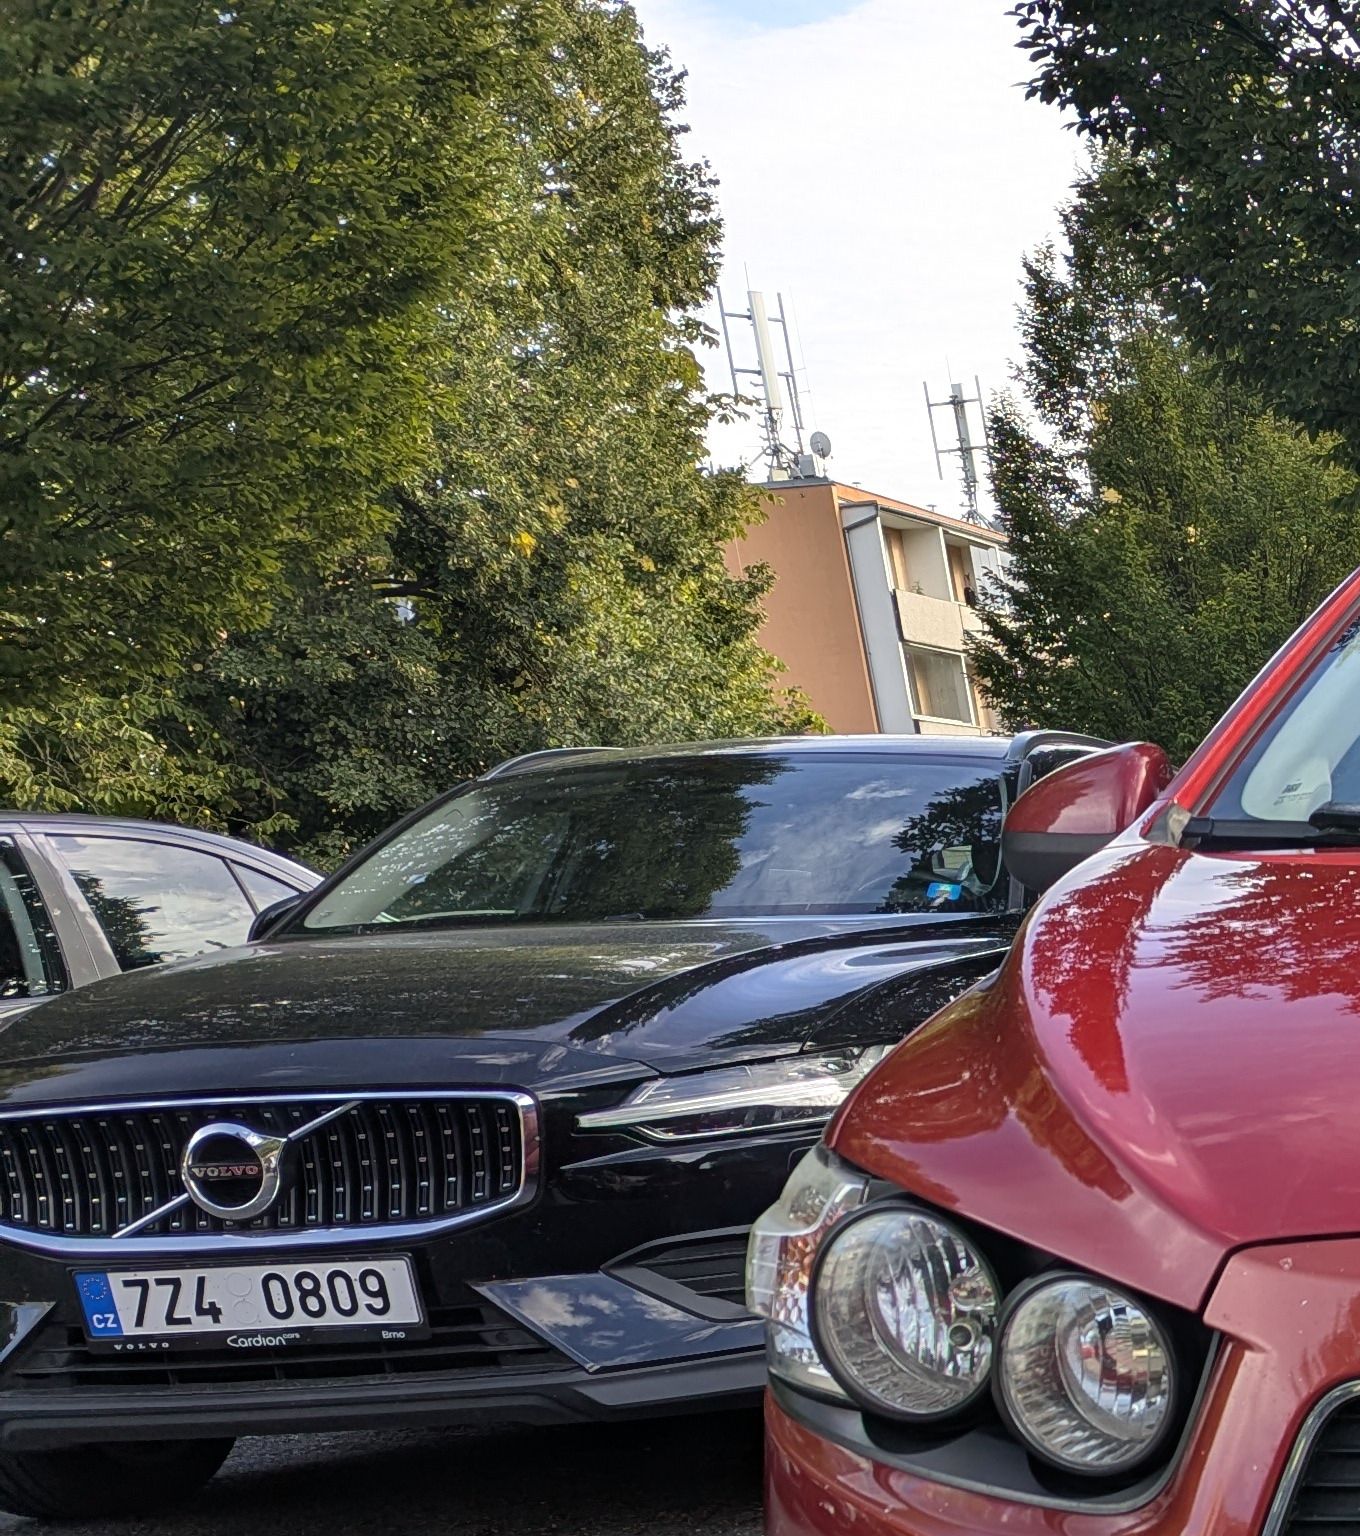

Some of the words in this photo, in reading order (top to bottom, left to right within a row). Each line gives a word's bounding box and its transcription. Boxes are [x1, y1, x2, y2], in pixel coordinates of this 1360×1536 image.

[192, 1165, 259, 1178] VOLVO
[92, 1313, 118, 1329] CZ
[121, 1275, 223, 1328] 7Z4
[261, 1269, 391, 1320] 0809
[114, 1342, 170, 1351] VOLVO
[227, 1334, 286, 1349] Cardion
[382, 1330, 405, 1340] Brno
